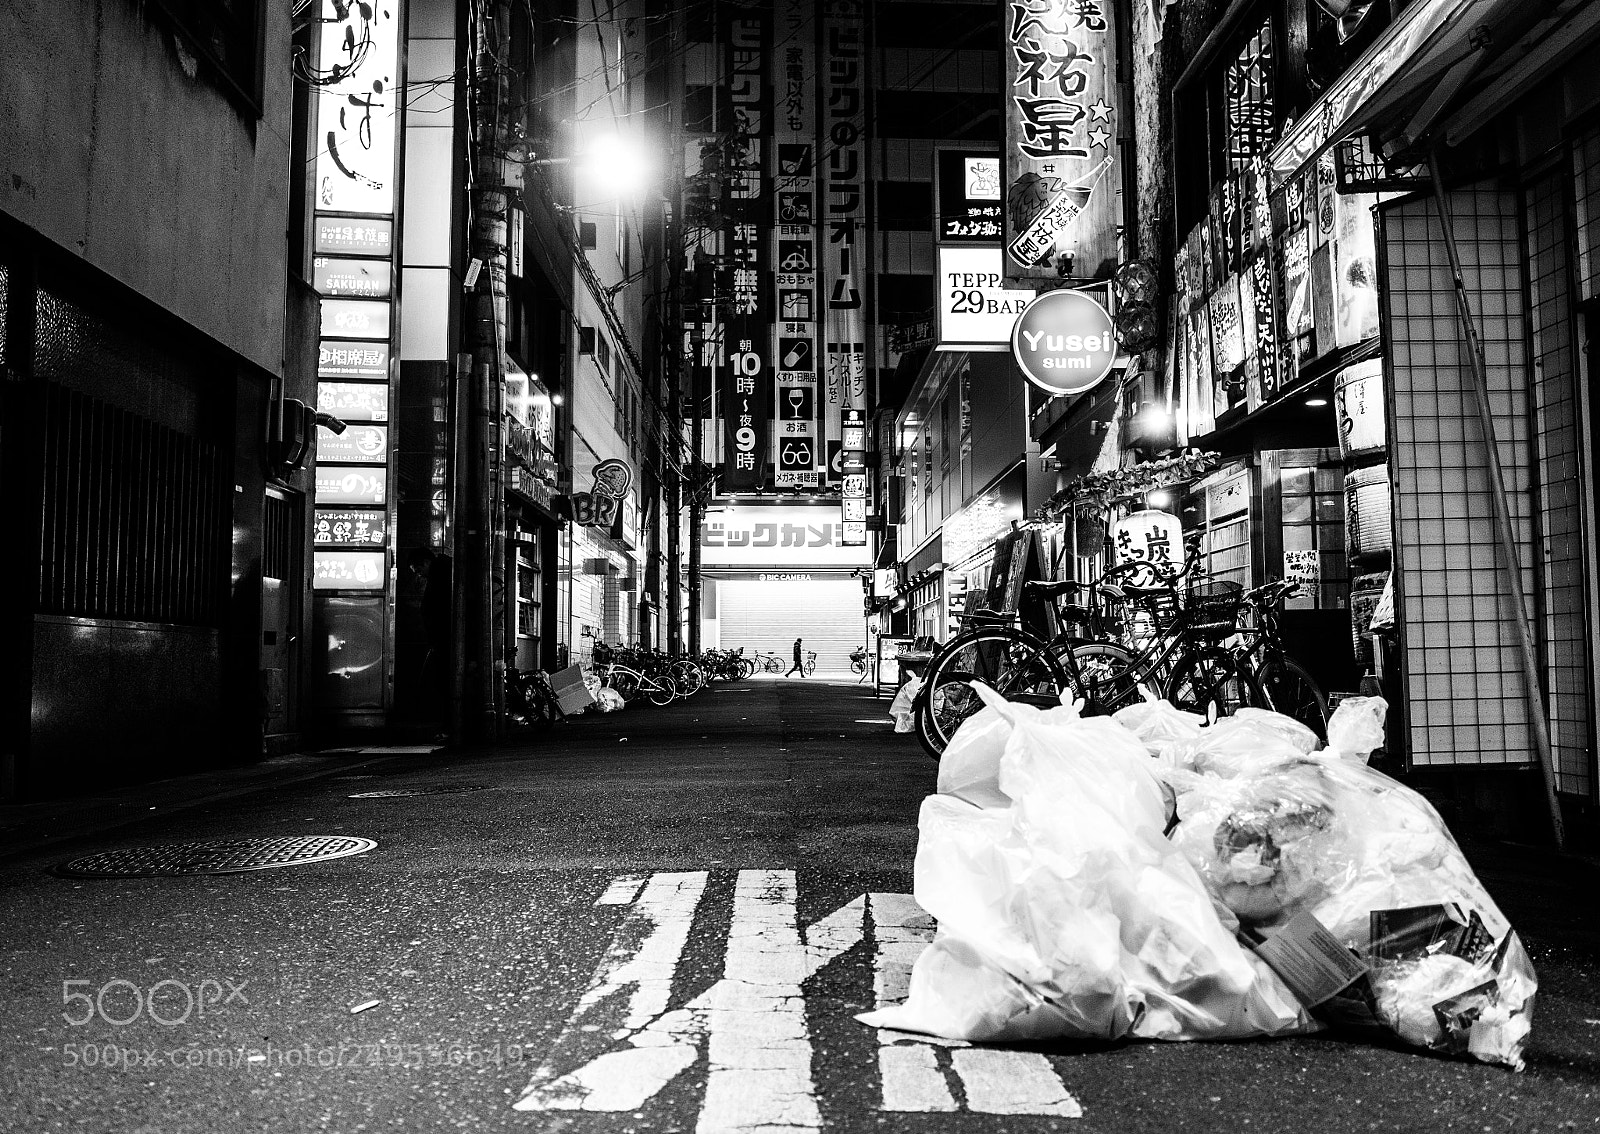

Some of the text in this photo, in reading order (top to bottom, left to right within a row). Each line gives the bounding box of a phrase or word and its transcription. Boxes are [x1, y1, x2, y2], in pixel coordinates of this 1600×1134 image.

[314, 257, 328, 268] 8F
[326, 279, 379, 290] SAKURAN
[776, 274, 814, 285] おもちゃ
[951, 290, 1026, 314] 29 BAR
[785, 323, 806, 334] 寝具
[1022, 330, 1111, 352] Yusei
[1042, 356, 1092, 369] sumi
[827, 353, 839, 404] トイレなど
[840, 353, 852, 409] バスルーム
[854, 353, 865, 398] キッチン
[785, 423, 807, 433] お酒
